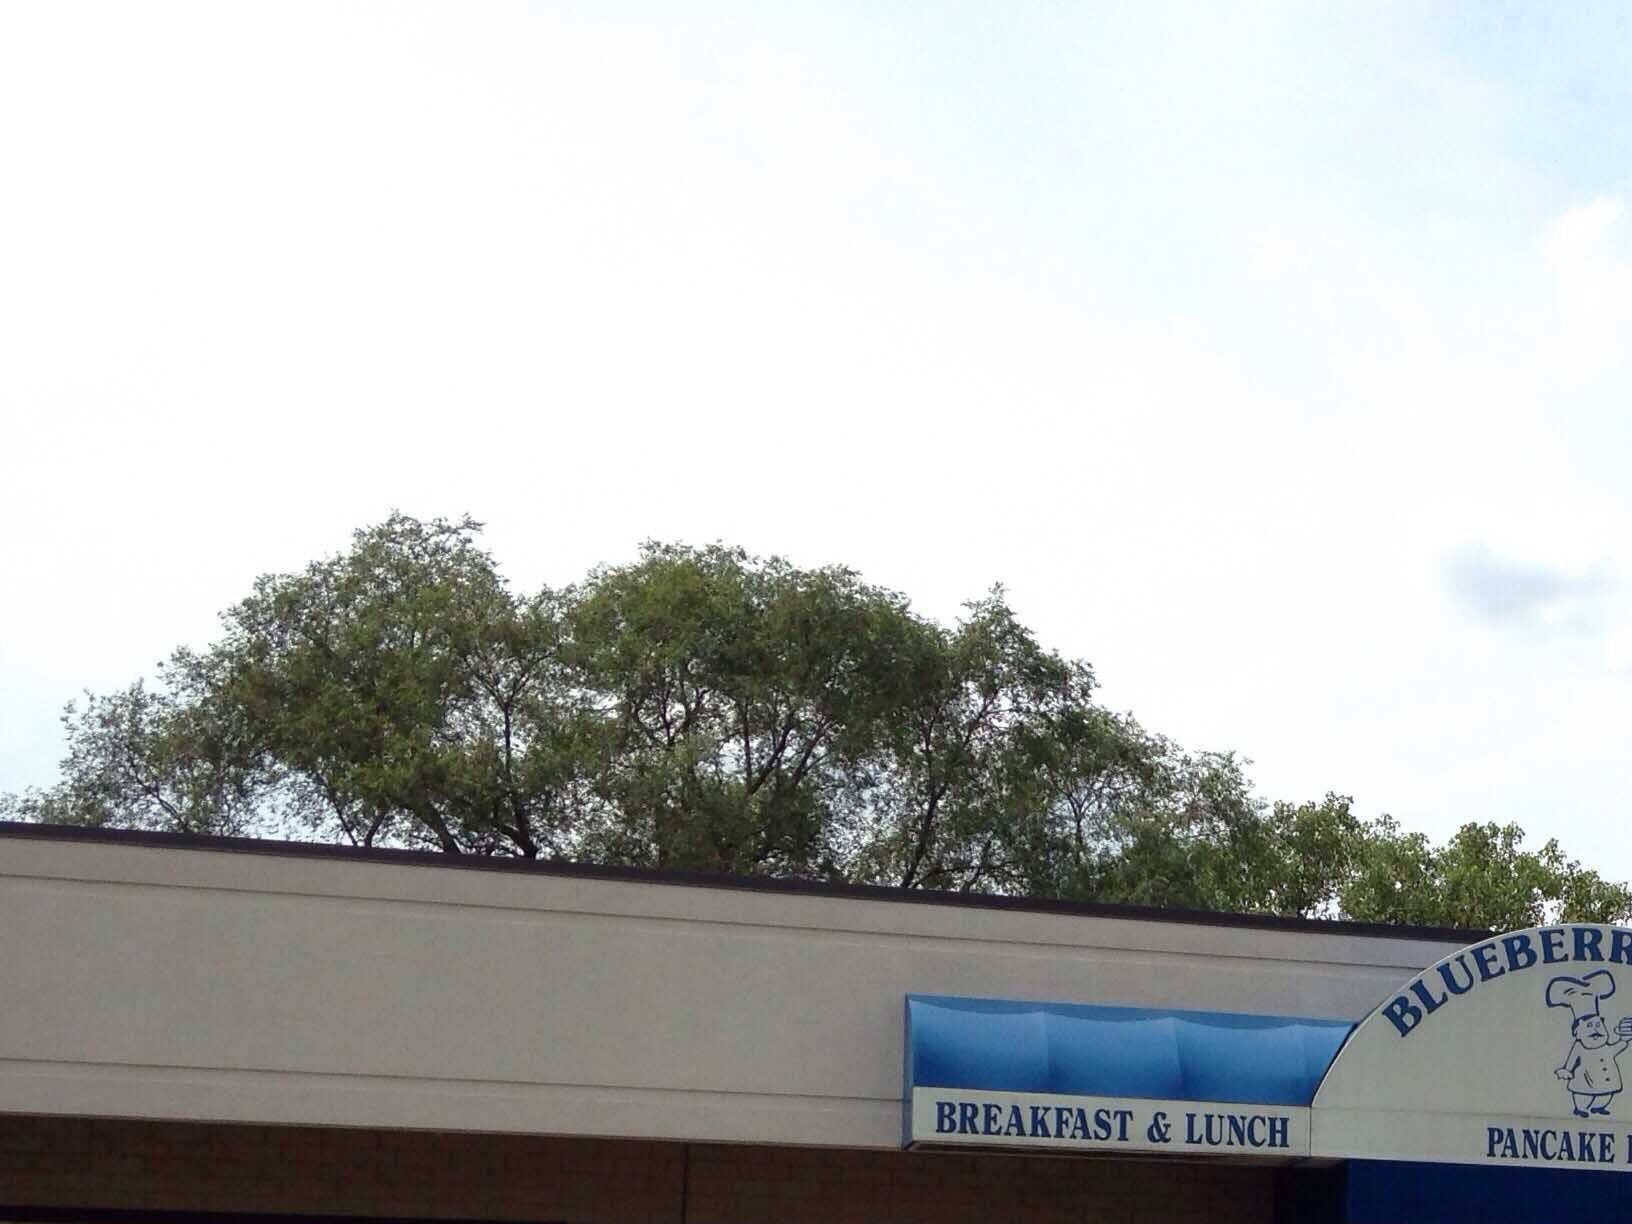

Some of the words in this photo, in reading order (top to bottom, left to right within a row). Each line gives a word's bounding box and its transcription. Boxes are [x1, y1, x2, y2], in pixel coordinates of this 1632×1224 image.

[935, 1101, 1133, 1142] BREAKFAST
[1147, 1111, 1172, 1144] &
[1185, 1112, 1290, 1148] LUNCH
[1487, 1127, 1615, 1163] PANCAKE
